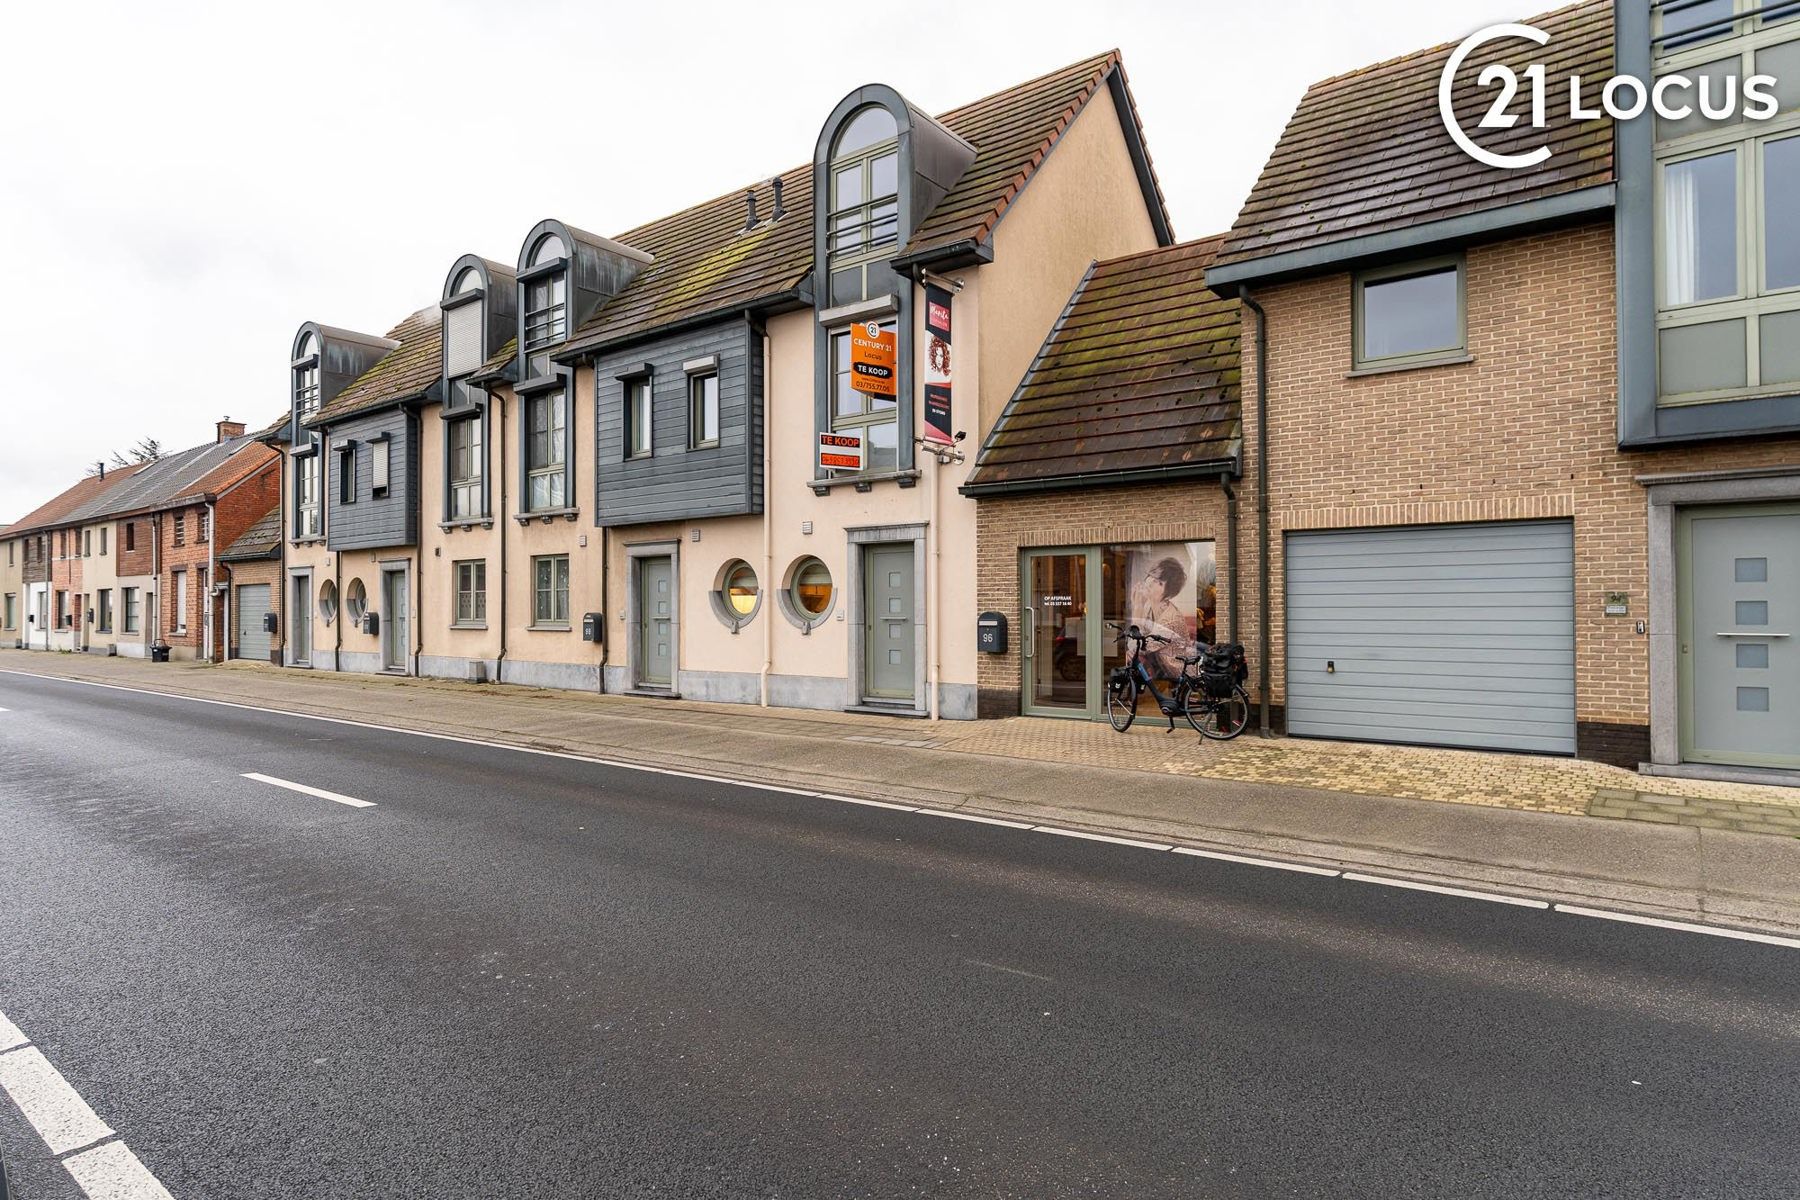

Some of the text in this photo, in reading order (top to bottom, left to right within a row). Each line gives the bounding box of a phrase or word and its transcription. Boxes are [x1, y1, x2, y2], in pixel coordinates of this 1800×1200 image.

[853, 338, 892, 352] CENTURY 21
[857, 364, 888, 377] TE KOOP
[822, 435, 859, 447] TE KOOP
[982, 633, 994, 643] 96
